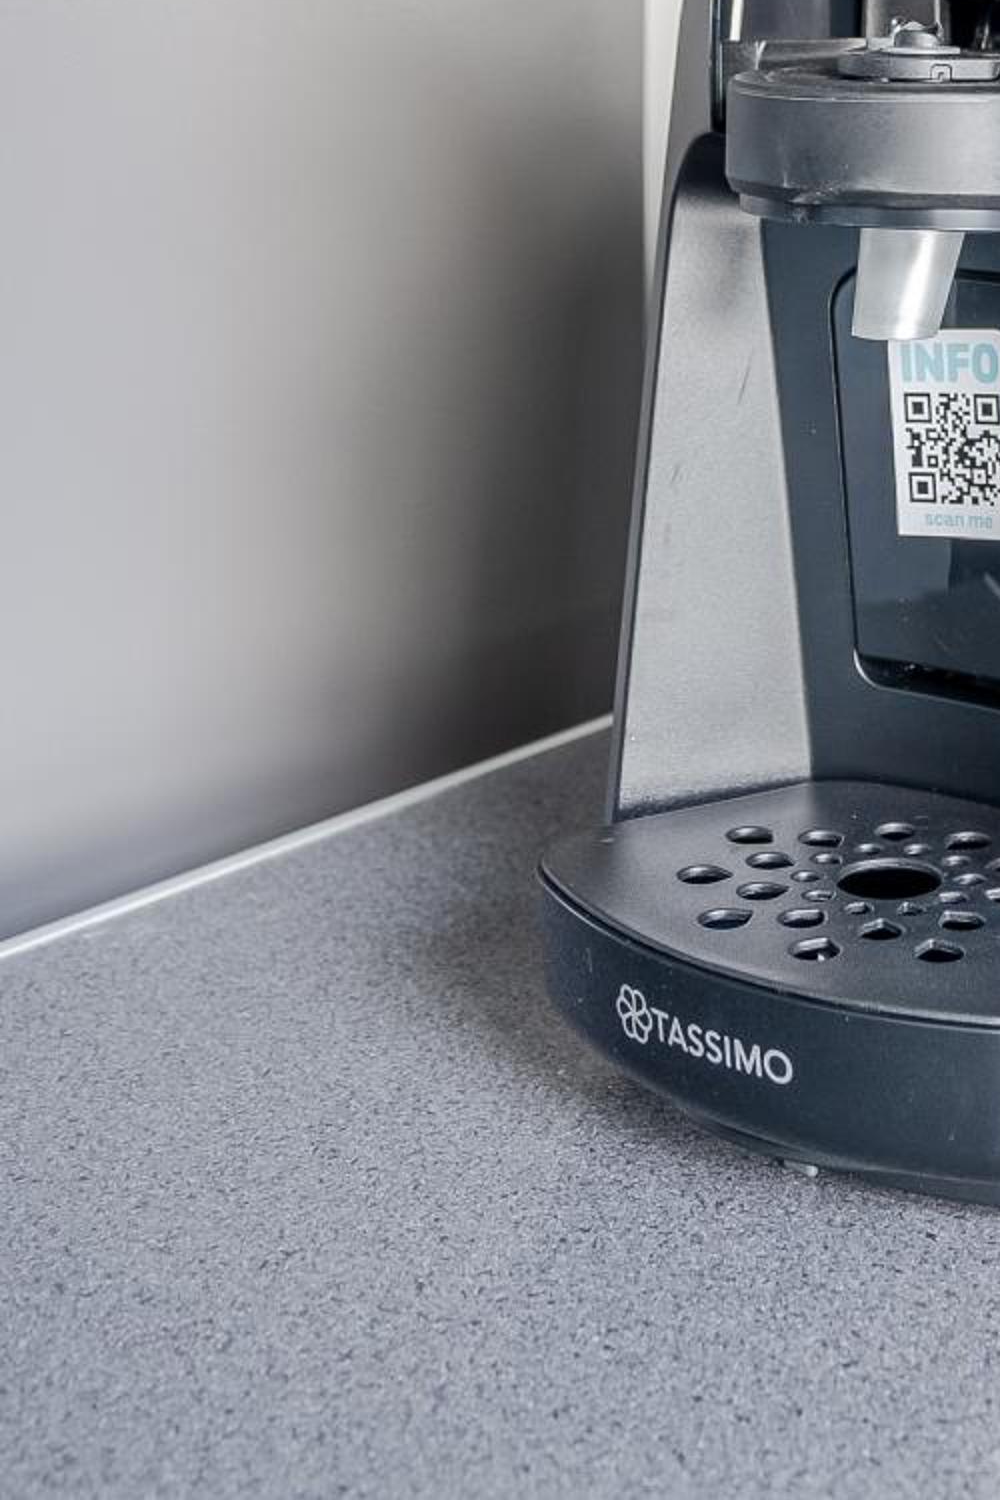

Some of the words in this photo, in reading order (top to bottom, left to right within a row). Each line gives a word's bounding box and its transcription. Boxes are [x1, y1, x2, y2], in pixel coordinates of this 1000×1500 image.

[899, 342, 1000, 384] INFO
[925, 512, 964, 528] scan
[967, 514, 993, 529] me
[651, 1007, 793, 1085] TASSIMO
